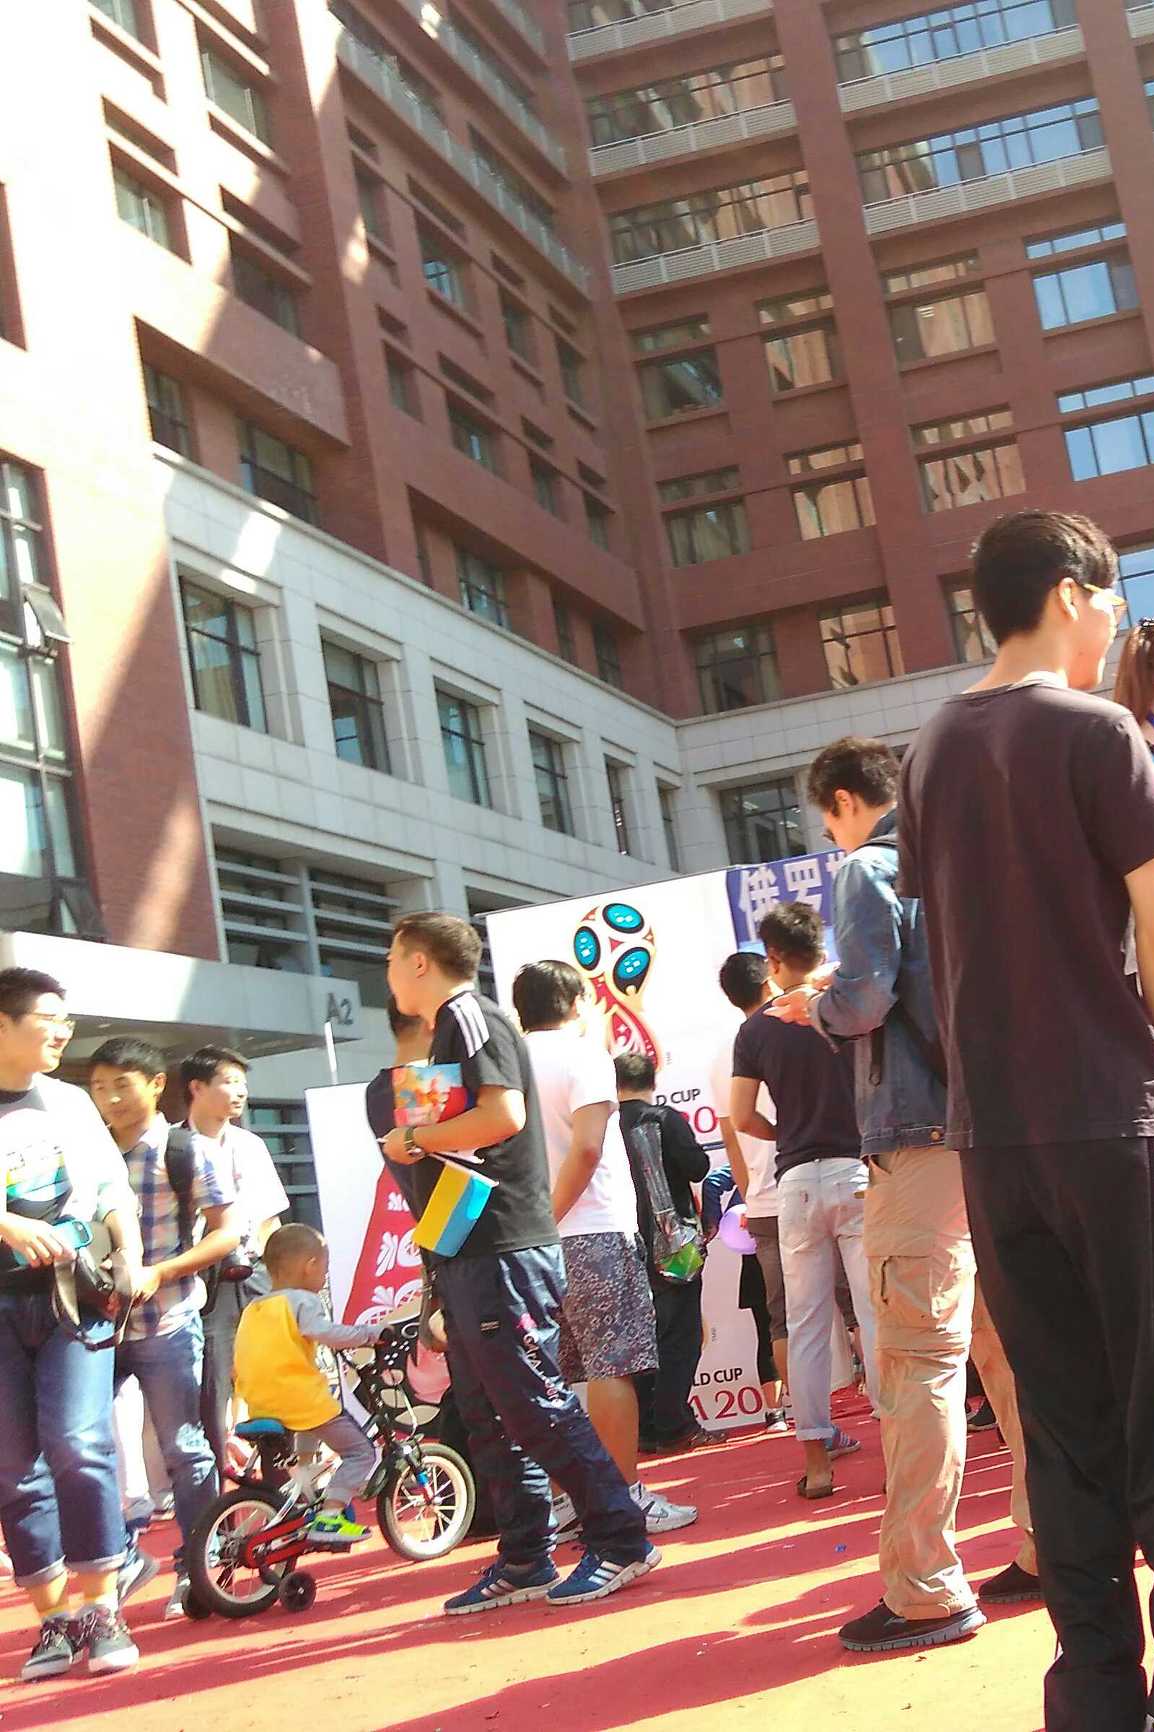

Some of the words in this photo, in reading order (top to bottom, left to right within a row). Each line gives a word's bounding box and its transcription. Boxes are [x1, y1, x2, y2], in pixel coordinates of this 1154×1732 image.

[739, 851, 847, 942] 俄罗
[324, 992, 354, 1025] A2
[670, 1088, 701, 1104] CUP
[713, 1367, 743, 1384] CUP
